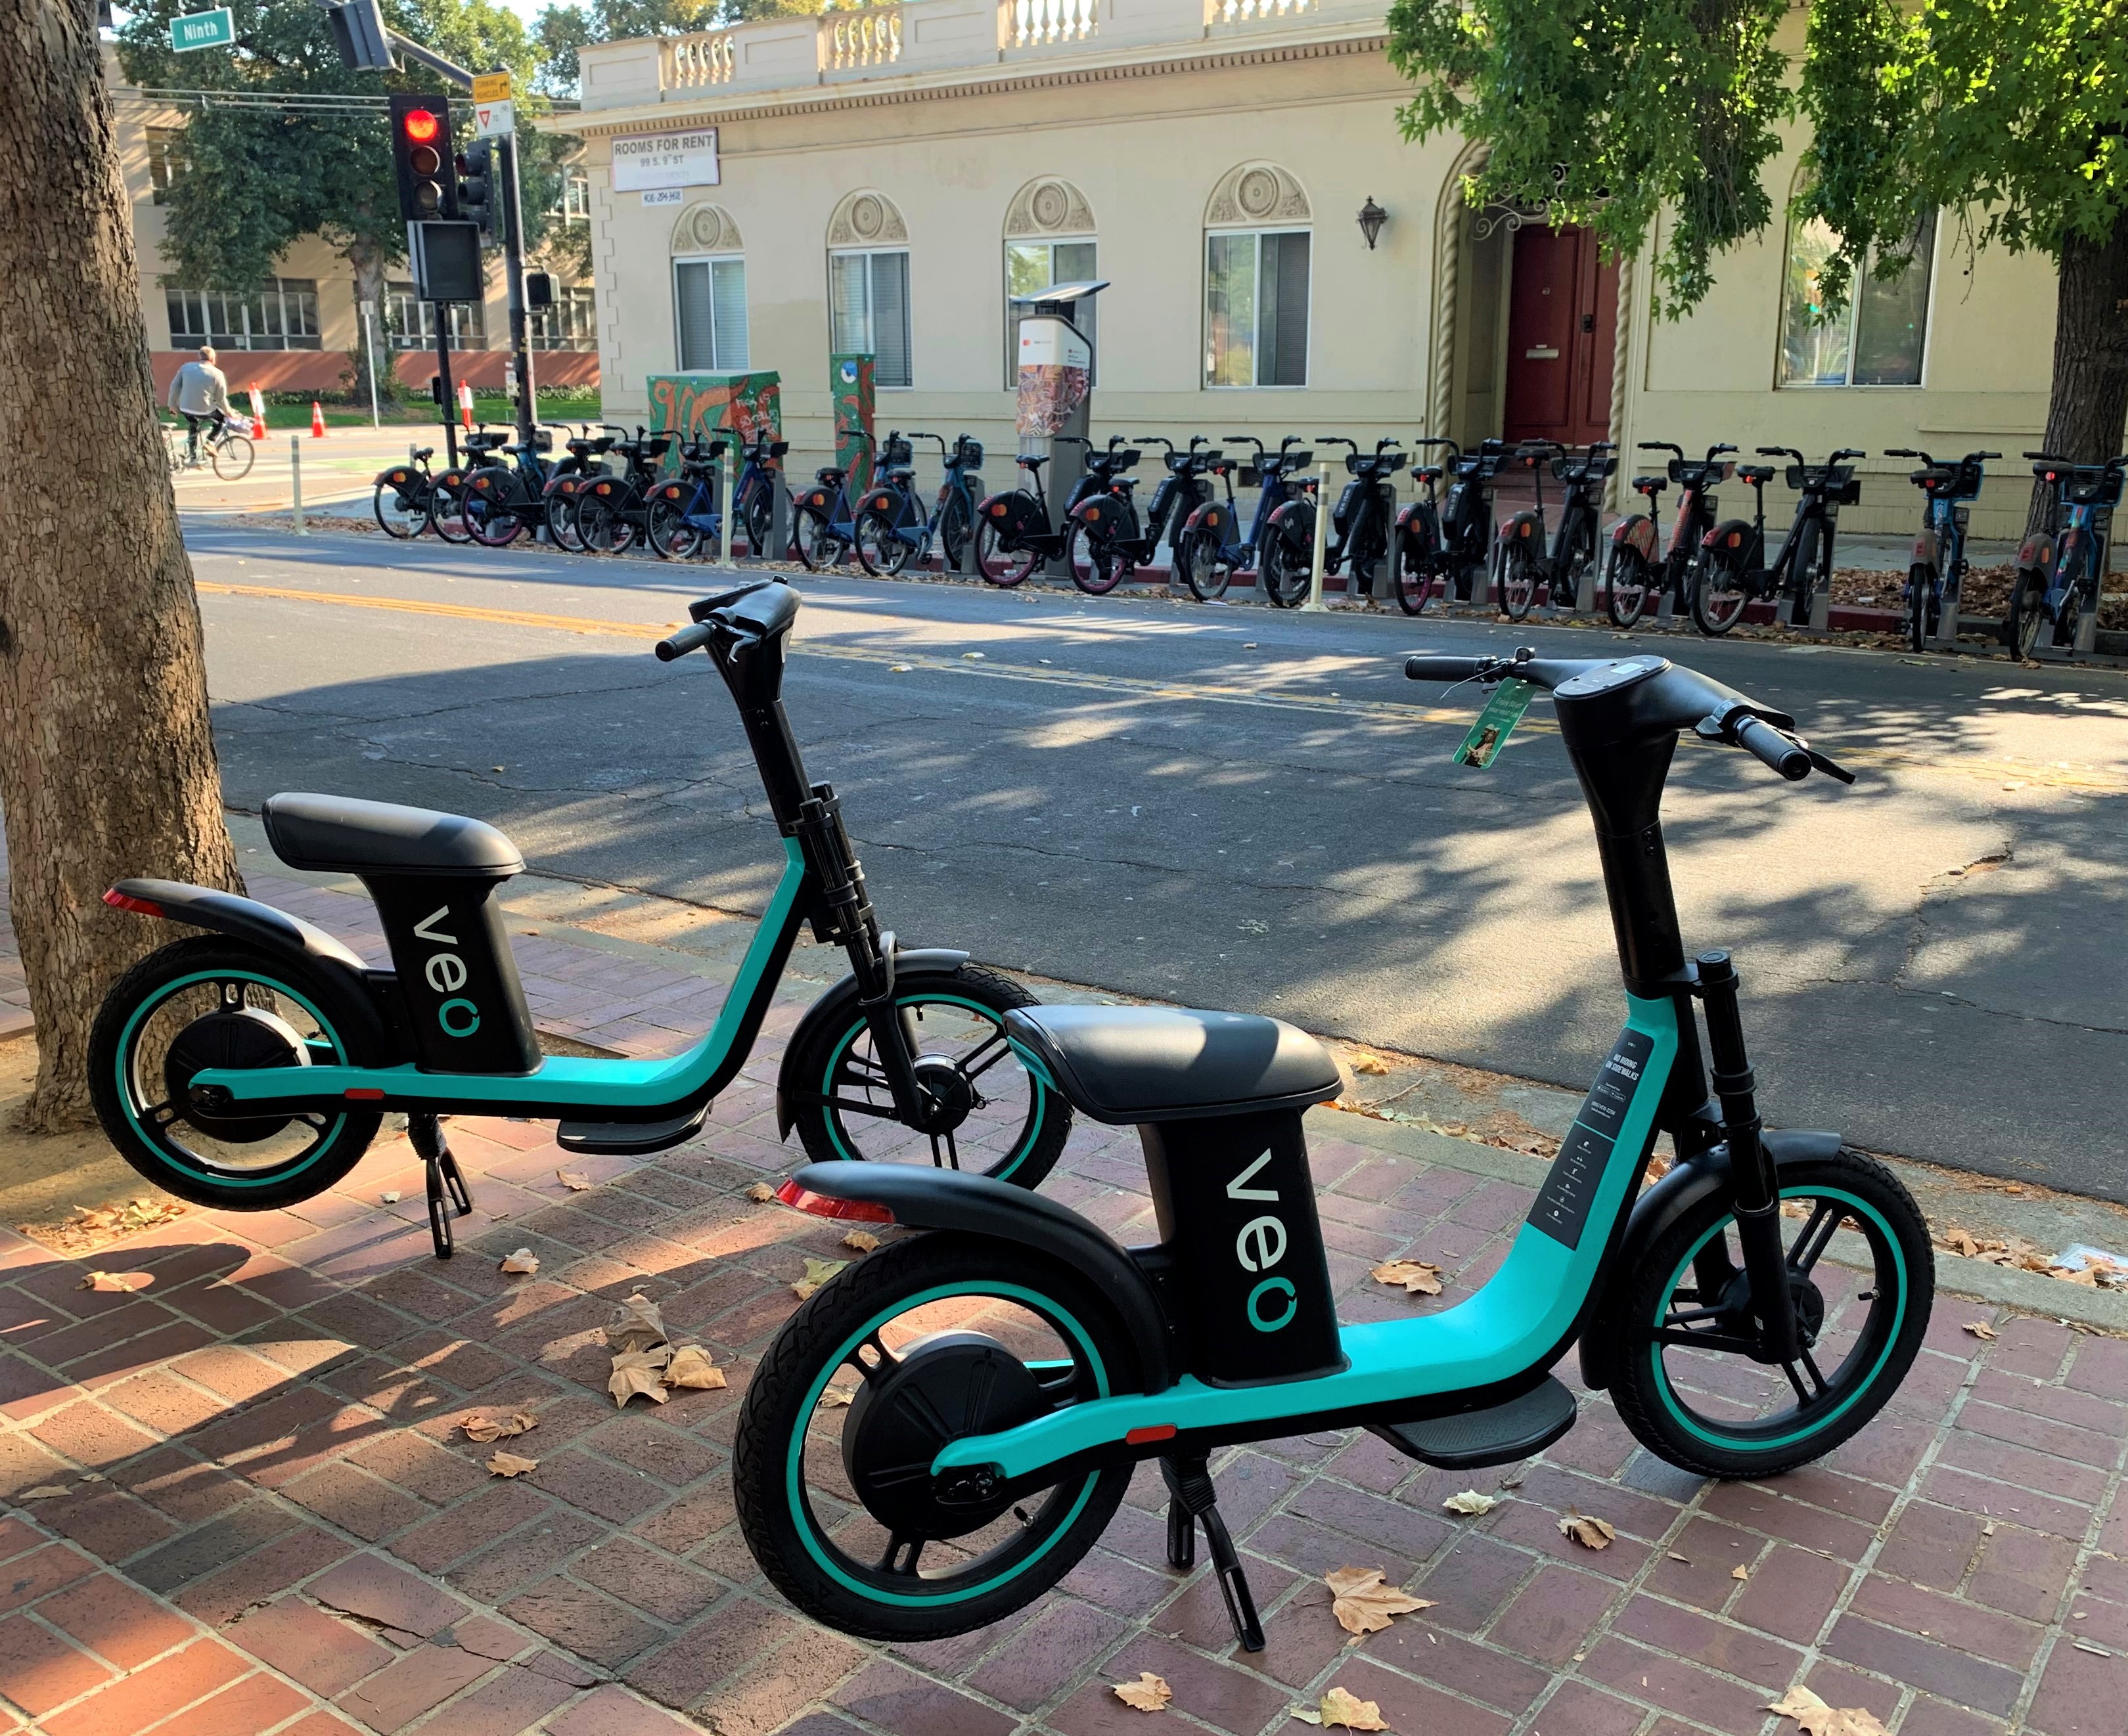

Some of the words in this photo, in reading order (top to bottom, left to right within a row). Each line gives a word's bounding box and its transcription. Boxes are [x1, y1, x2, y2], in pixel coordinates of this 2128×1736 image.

[184, 21, 218, 41] Ninth
[615, 141, 653, 155] ROOMS
[657, 137, 679, 152] FOR
[683, 135, 713, 149] RENT
[641, 158, 650, 167] 99
[673, 155, 684, 164] ST
[413, 904, 480, 1038] veo
[1605, 1060, 1614, 1069] ON
[1611, 1063, 1639, 1080] SIDEWALKS
[1613, 1053, 1621, 1062] NO
[1619, 1056, 1638, 1069] RIDING
[1226, 1147, 1298, 1332] veo
